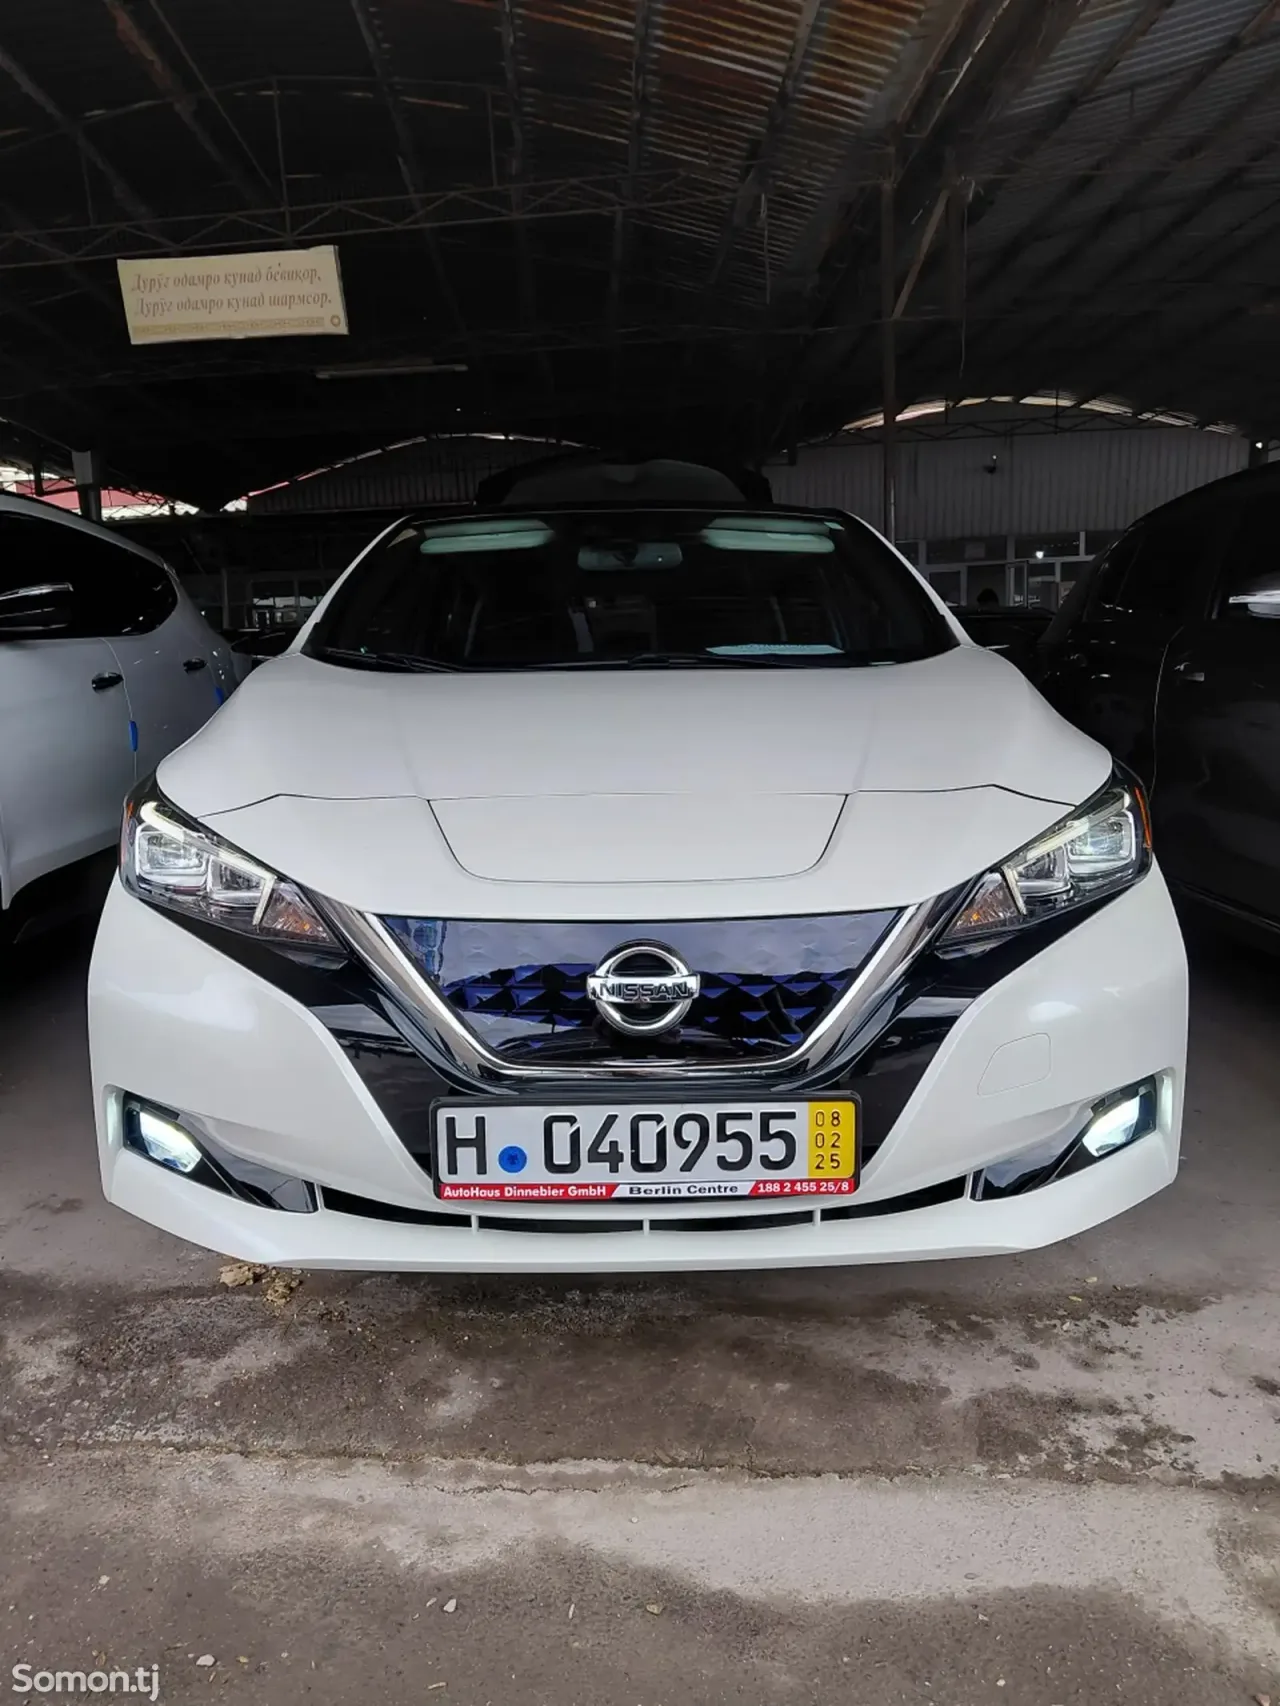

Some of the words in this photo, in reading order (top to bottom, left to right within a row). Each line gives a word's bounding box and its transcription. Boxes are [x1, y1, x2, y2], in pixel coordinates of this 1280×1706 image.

[599, 982, 689, 1000] NISSAN
[814, 1110, 841, 1127] 08
[444, 1115, 487, 1175] H
[543, 1111, 797, 1174] 040955
[814, 1132, 841, 1149] 02
[814, 1153, 841, 1170] 25
[443, 1186, 501, 1199] AutoHaus
[504, 1185, 565, 1198] Dinnebier
[568, 1185, 606, 1197] GmbH
[629, 1184, 683, 1195] Berlin
[686, 1183, 739, 1195] Centre
[757, 1183, 780, 1194] 188
[783, 1182, 793, 1193] 2
[794, 1182, 817, 1193] 455
[819, 1181, 850, 1193] 25/8
